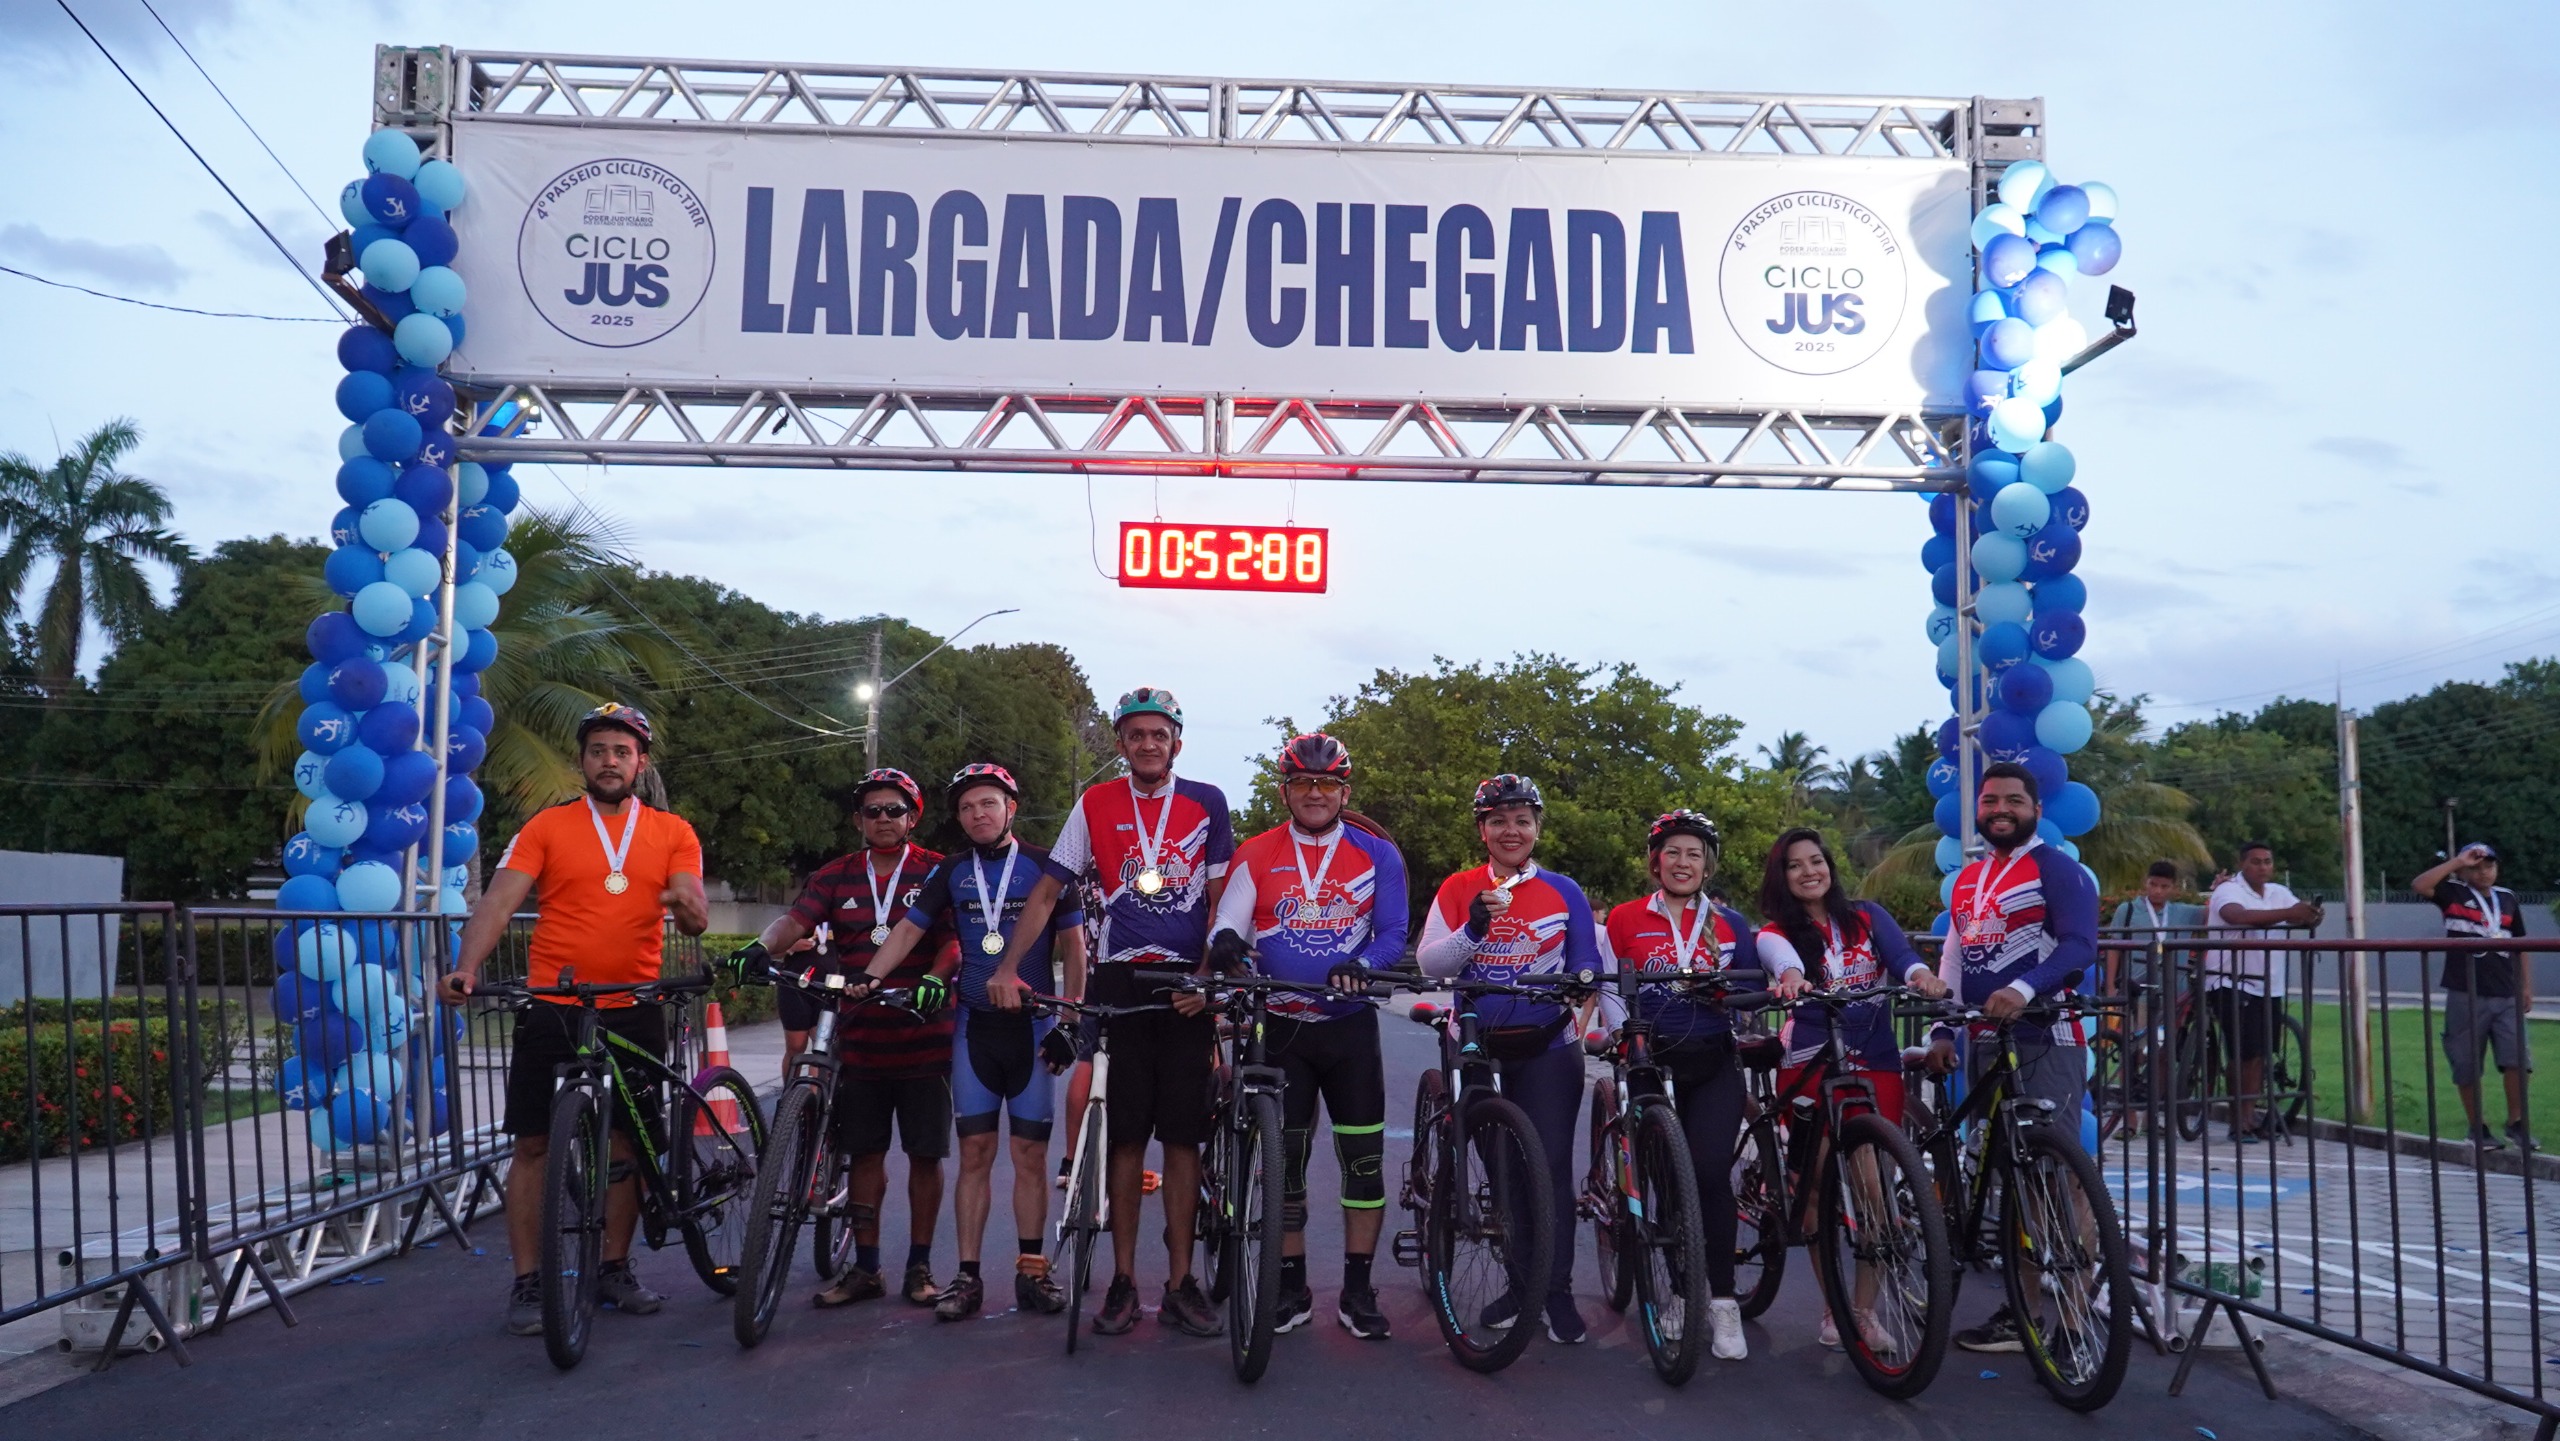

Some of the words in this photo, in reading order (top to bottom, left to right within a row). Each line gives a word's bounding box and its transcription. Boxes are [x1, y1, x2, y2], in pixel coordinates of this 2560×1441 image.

[383, 197, 406, 217] 34
[536, 200, 549, 221] 4º
[545, 165, 601, 203] PASSEIO
[606, 162, 705, 229] CICLÍSTICO-TJRR
[611, 215, 654, 223] JUDICIÁRIO
[1742, 197, 1793, 236] PASSEIO
[565, 233, 670, 261] CICLO
[741, 186, 1696, 355] LARGADA/CHEGADA
[1764, 265, 1864, 289] CICLO
[564, 262, 670, 308] JUS
[591, 314, 634, 327] 2025
[1766, 293, 1866, 335] JUS
[1795, 342, 1835, 352] 2025
[1474, 937, 1517, 953] edal
[1474, 953, 1537, 965] ORDEM
